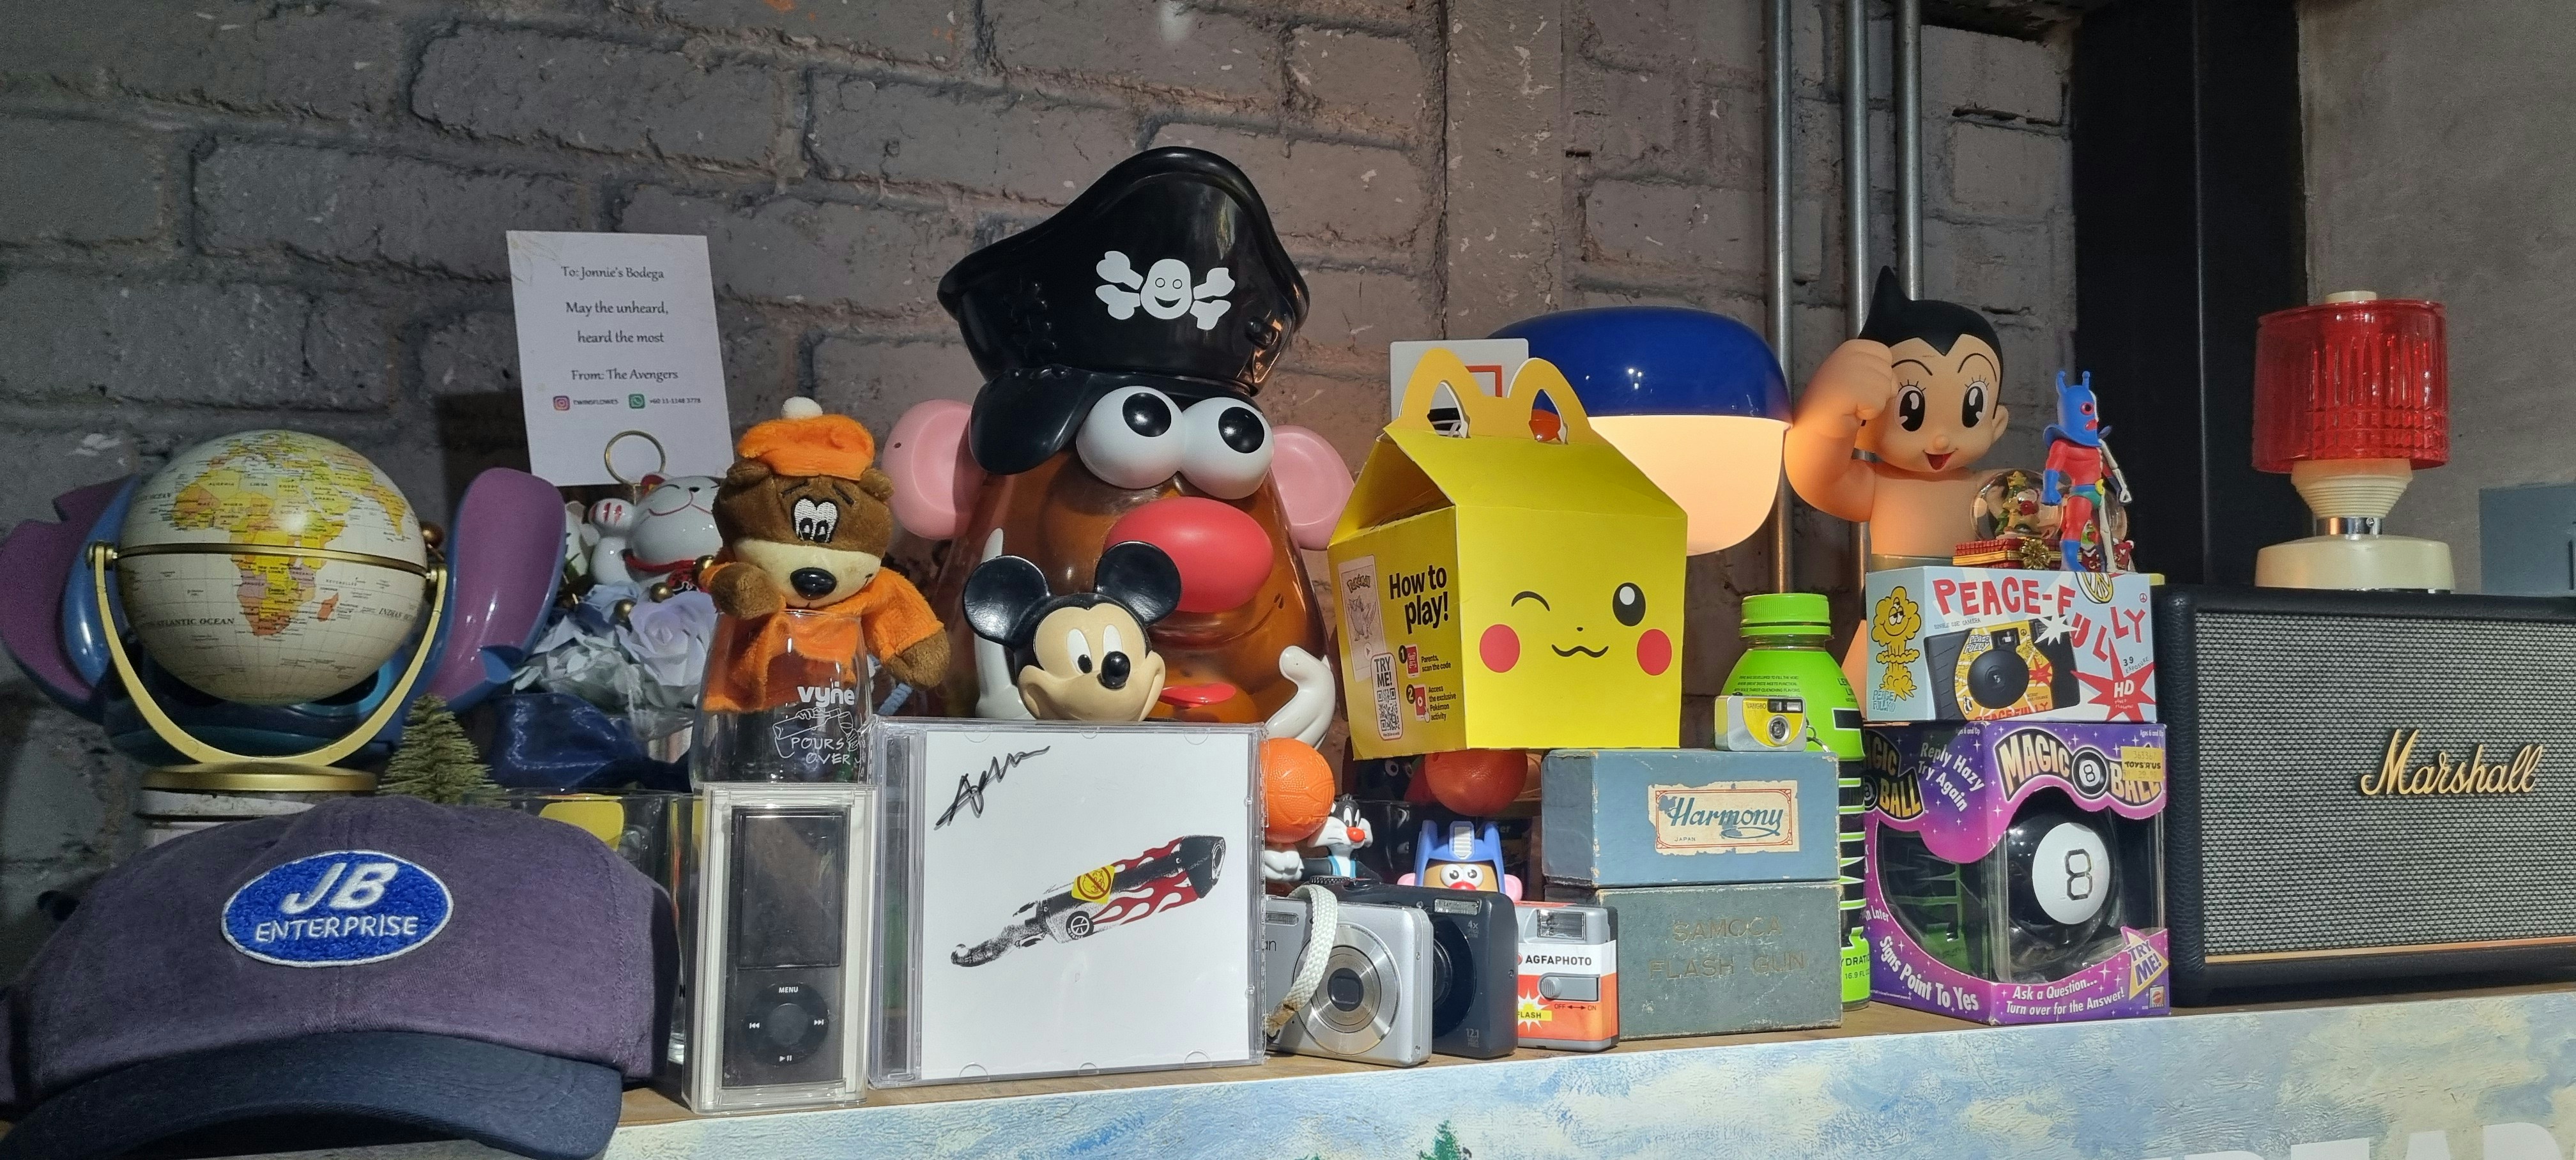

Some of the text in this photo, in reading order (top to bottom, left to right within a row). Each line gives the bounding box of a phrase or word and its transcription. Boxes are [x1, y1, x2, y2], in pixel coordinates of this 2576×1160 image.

[561, 266, 664, 282] To: Jonnie's Bodega
[565, 300, 669, 317] May the unheard,
[578, 330, 664, 343] heard the most
[571, 367, 678, 383] From: The Avengers
[1389, 565, 1447, 600] How to
[1404, 591, 1449, 635] play!
[1374, 656, 1391, 673] TRY
[1440, 661, 1452, 669] code
[2123, 656, 2134, 667] 39
[2126, 656, 2149, 674] EXPOSURE
[1377, 671, 1393, 688] ME!
[1429, 685, 1444, 694] Access
[1437, 692, 1457, 701] exclusive
[2113, 680, 2135, 698] HD
[1431, 712, 1446, 721] activity
[791, 737, 845, 750] POURS
[806, 752, 851, 765] OVER
[1920, 742, 1985, 791] Reply Hazy
[1999, 734, 2070, 796] MAGIC
[2083, 763, 2096, 783] 8
[2361, 728, 2544, 796] Marshall
[1918, 760, 1968, 812] Try Again
[1879, 774, 1922, 818] BALL
[1667, 797, 1784, 839] Harmony
[2064, 848, 2093, 901] 8
[279, 862, 399, 915] JB
[1871, 905, 1889, 922] Later
[255, 914, 419, 943] ENTERPRISE
[1468, 920, 1478, 929] 4x
[1673, 916, 1782, 942] SAMOCA
[1525, 954, 1592, 966] AGFAPHOTO
[2128, 940, 2152, 963] TRY
[1650, 950, 1805, 980] FLASH GUN
[1880, 935, 1979, 1011] Signs Point To Yes
[2135, 954, 2163, 989] ME!
[778, 986, 799, 994] MENU
[2012, 979, 2097, 1001] Ask a Question...
[2006, 986, 2126, 1017] Turn over for the Answer!
[1466, 1028, 1480, 1038] 12.1
